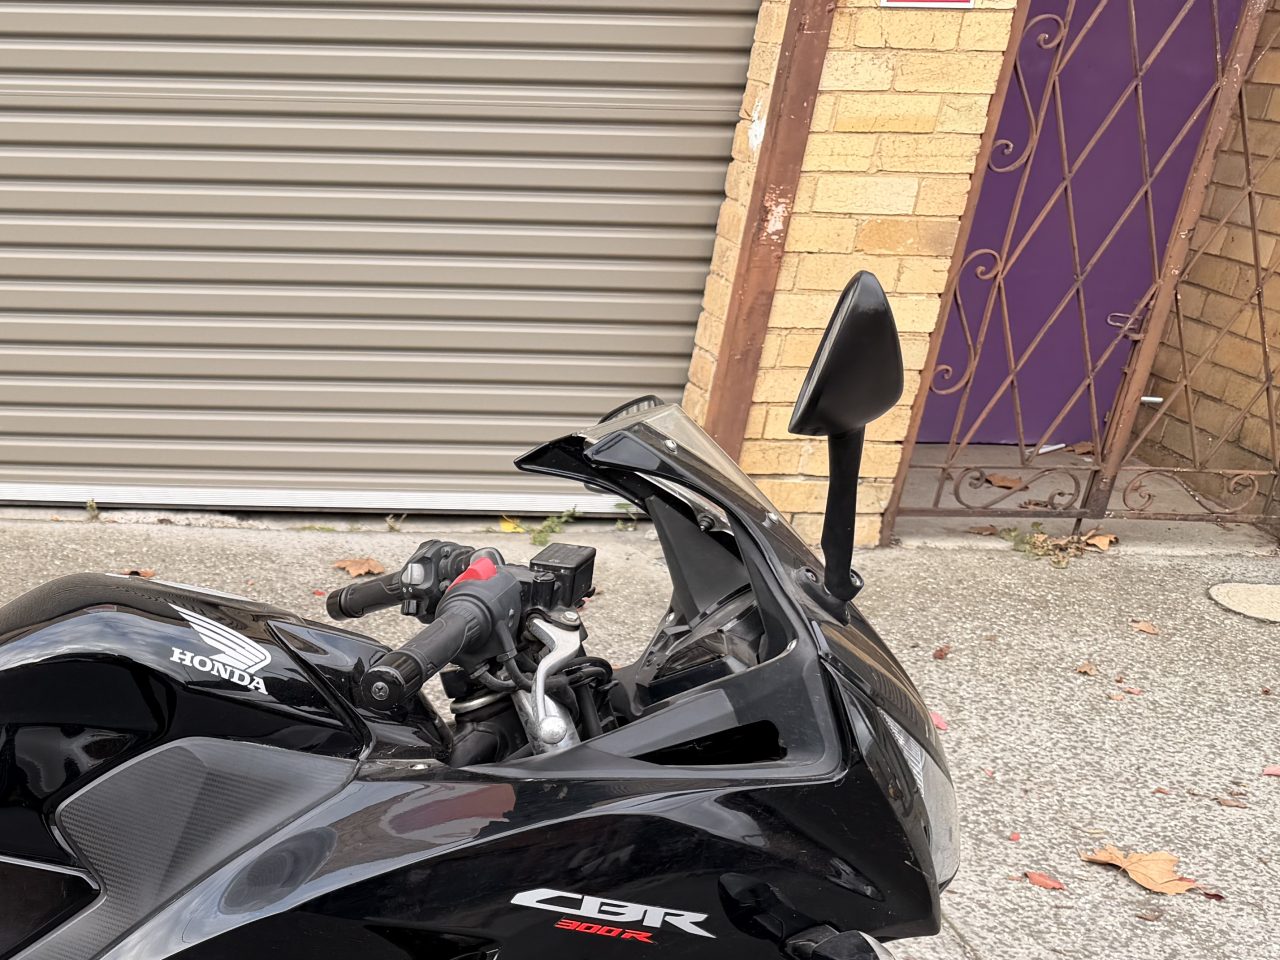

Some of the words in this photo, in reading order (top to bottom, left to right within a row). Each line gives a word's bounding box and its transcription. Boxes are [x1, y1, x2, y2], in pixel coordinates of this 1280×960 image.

[170, 647, 268, 695] HONDA
[510, 888, 717, 938] CBR
[554, 917, 658, 944] 300R
